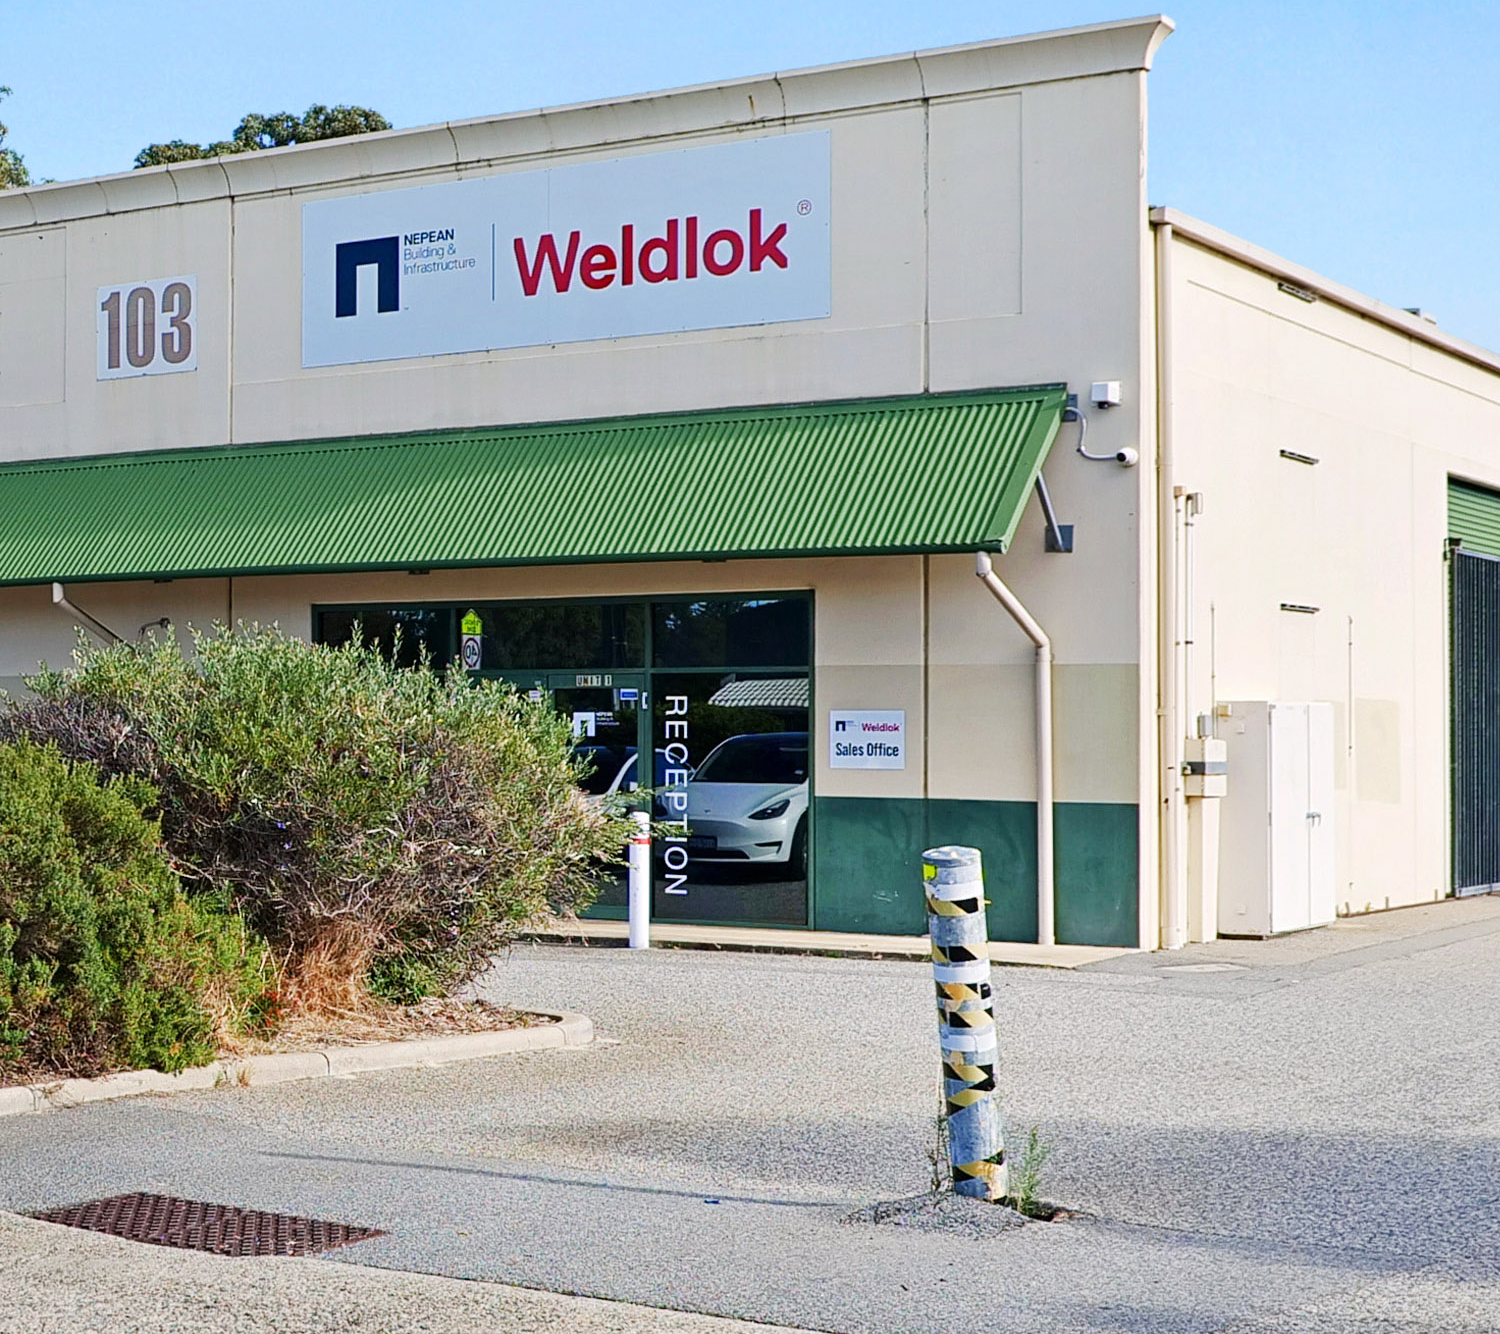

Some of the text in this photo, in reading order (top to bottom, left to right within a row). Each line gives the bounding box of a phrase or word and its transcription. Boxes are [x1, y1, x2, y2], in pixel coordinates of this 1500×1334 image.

[403, 228, 455, 246] NEPEAN
[403, 243, 456, 261] Building &
[513, 208, 789, 297] Weldlok
[403, 257, 476, 275] Infrastructure
[101, 282, 192, 369] 103
[577, 675, 601, 686] UNIT
[861, 722, 900, 732] Weldlok
[835, 742, 899, 757] Sales Office
[664, 695, 689, 895] RECEPTION
